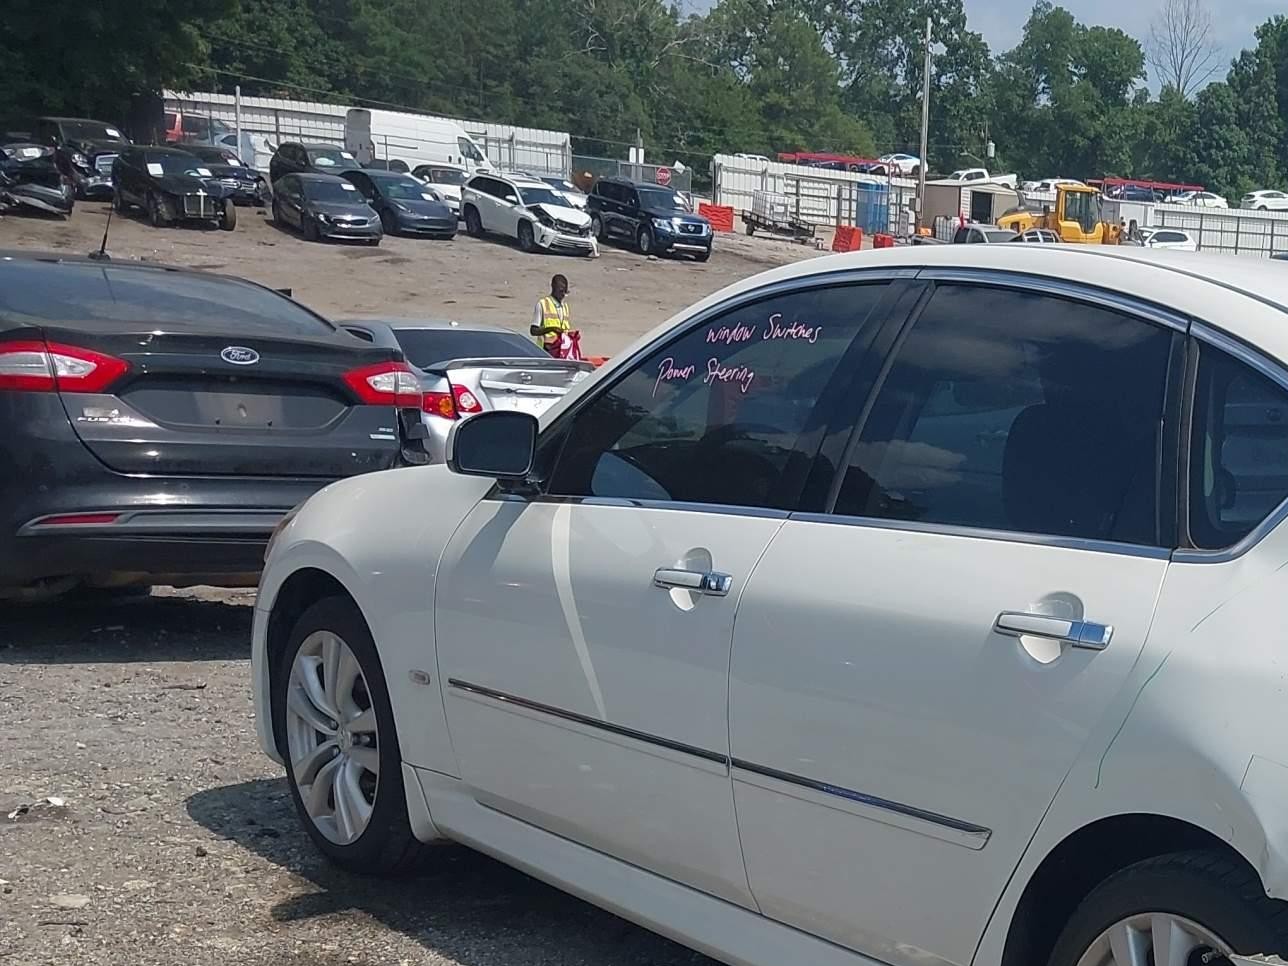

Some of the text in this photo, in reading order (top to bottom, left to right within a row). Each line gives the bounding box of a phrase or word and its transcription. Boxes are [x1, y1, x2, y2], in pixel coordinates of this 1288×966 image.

[763, 314, 822, 343] Switches
[652, 357, 754, 398] Power Steering
